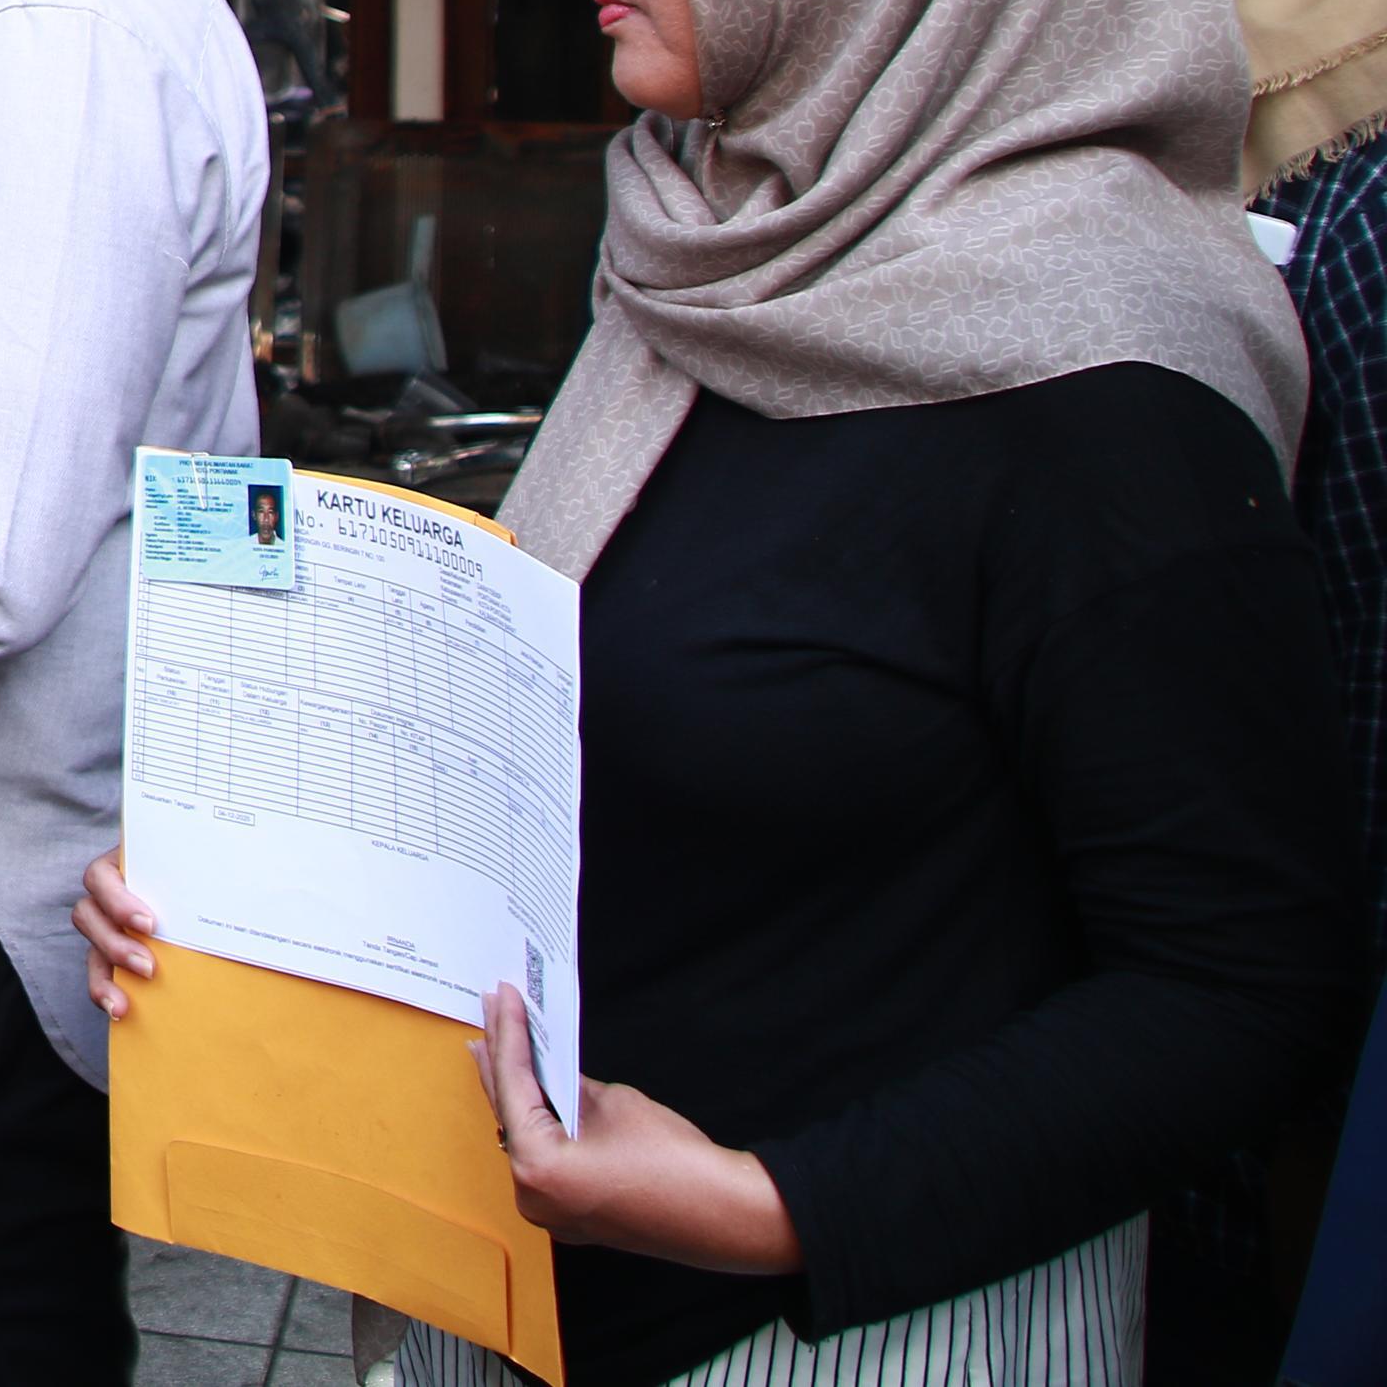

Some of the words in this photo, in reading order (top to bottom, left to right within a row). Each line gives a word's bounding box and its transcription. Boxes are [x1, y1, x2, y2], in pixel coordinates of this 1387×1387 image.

[295, 508, 324, 529] No.
[317, 490, 376, 520] KARTU
[382, 504, 465, 550] KELUARGA
